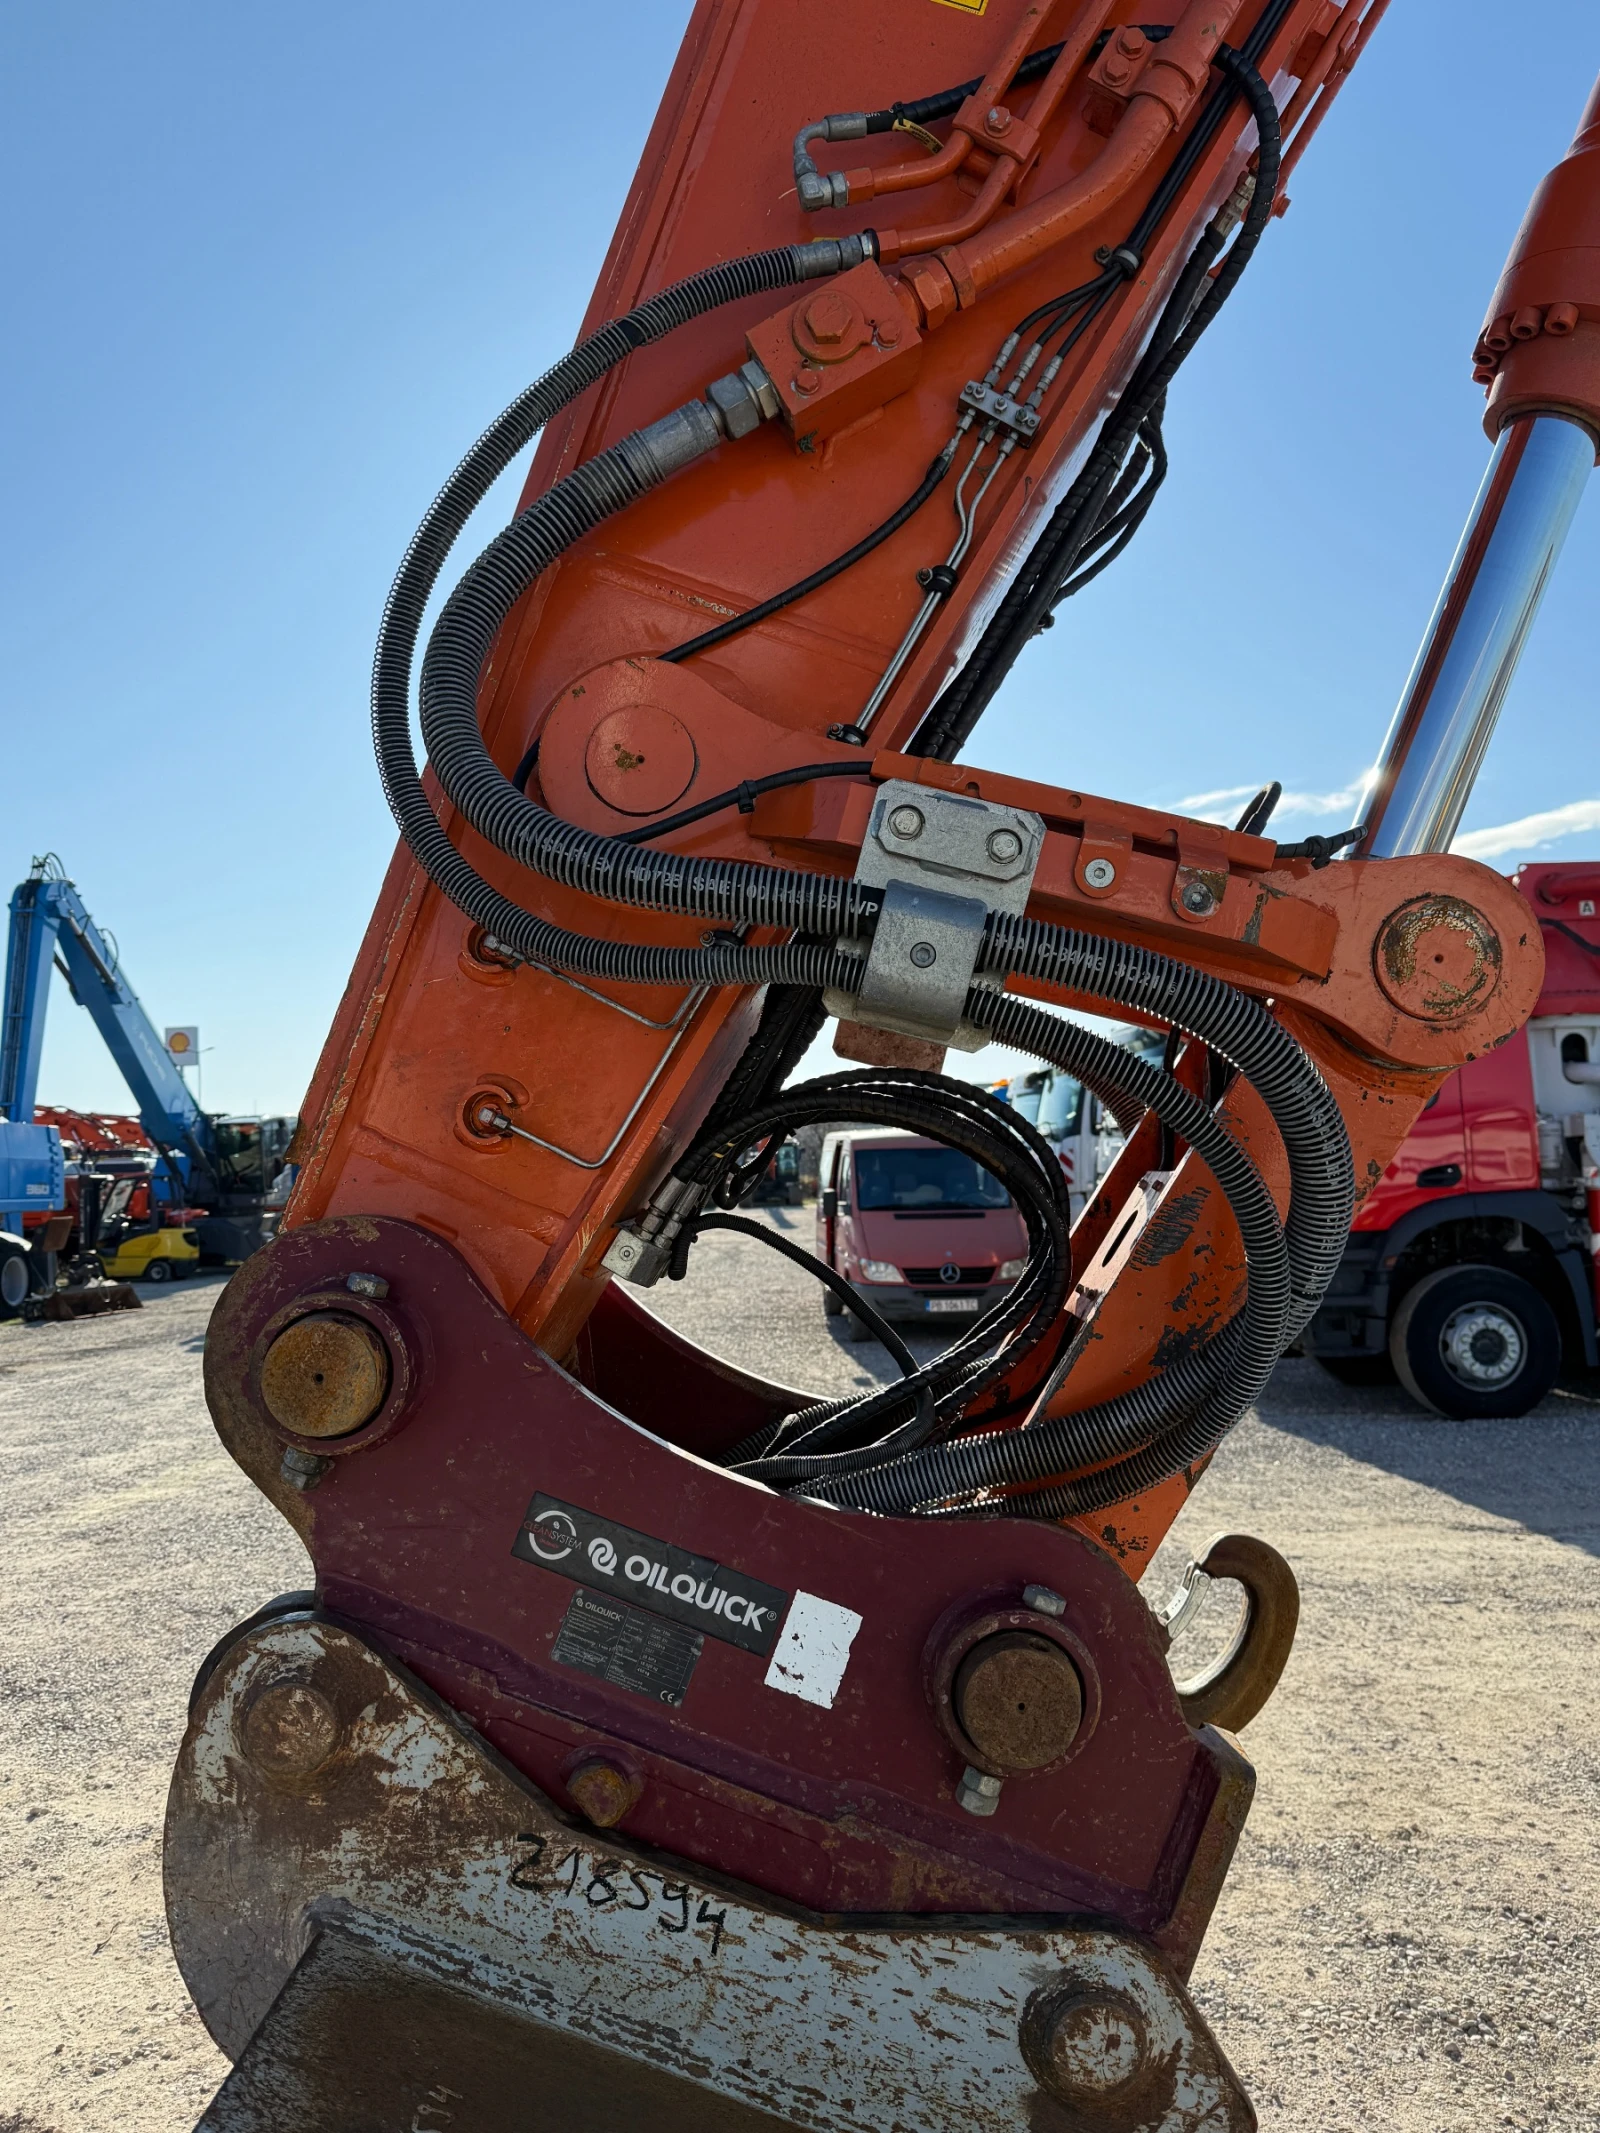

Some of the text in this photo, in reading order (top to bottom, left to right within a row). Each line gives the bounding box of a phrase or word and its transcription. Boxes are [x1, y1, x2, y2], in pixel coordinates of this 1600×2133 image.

[692, 876, 731, 895] SAE
[1582, 902, 1593, 913] A
[510, 1833, 727, 1955] 218594
